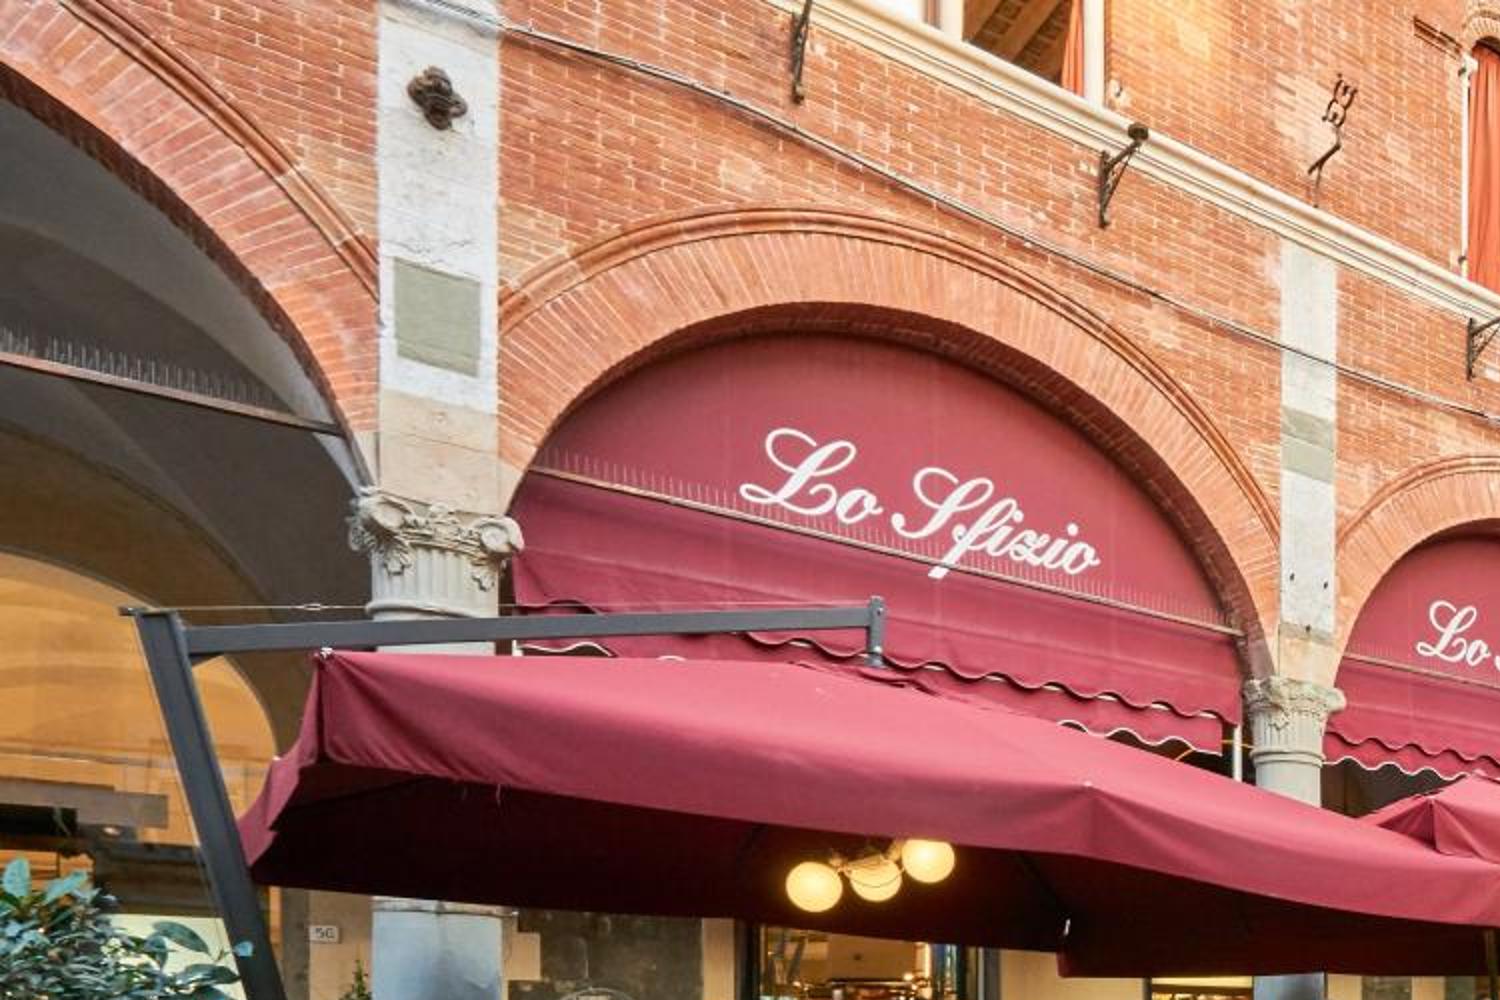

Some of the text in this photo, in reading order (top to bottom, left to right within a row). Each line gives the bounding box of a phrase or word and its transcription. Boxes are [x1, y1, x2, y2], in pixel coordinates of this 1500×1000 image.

[740, 428, 1100, 579] Lo Sfizio
[1416, 600, 1491, 666] Lo
